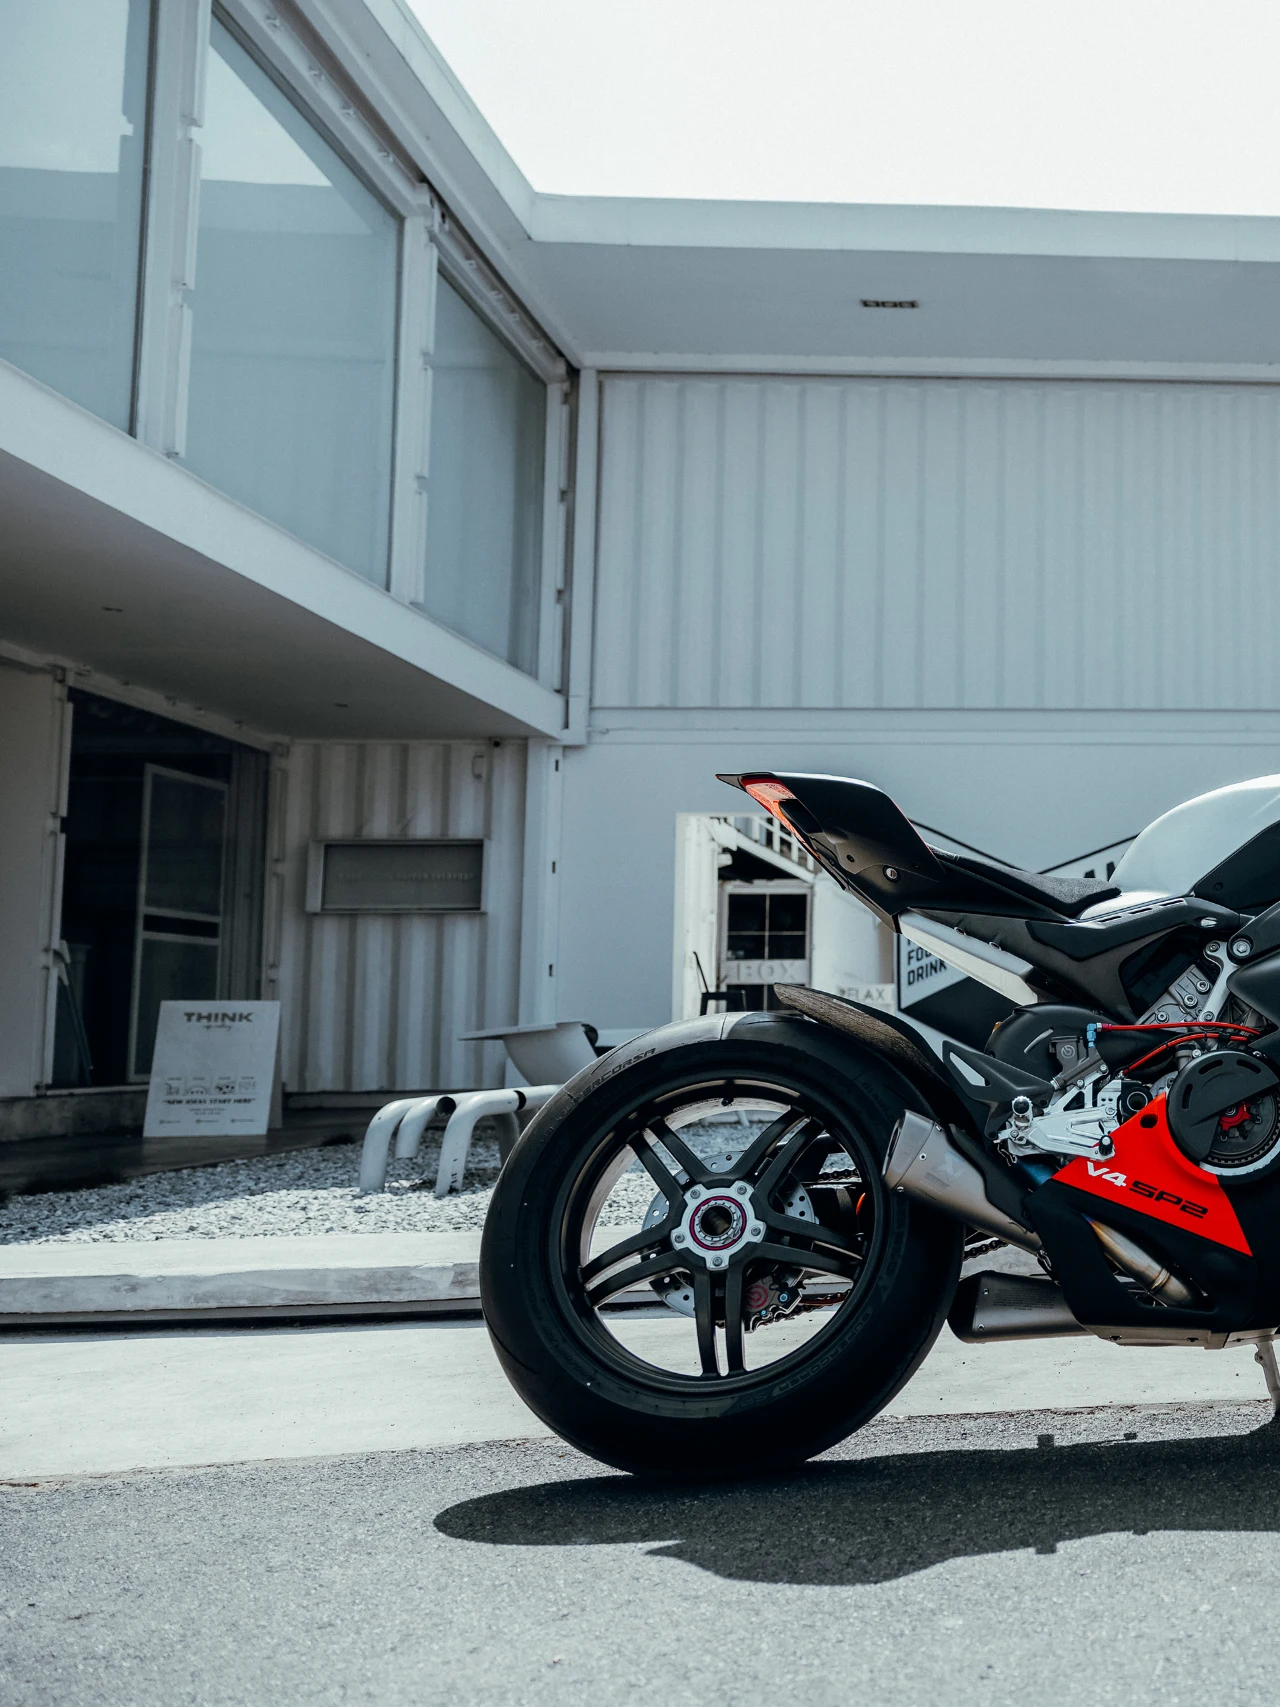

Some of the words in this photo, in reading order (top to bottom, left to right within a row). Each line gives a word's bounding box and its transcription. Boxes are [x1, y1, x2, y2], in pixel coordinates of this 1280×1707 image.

[737, 961, 797, 982] BOX
[907, 958, 947, 986] DRINK
[184, 1012, 254, 1023] THINK
[1087, 1161, 1127, 1187] V4
[1129, 1180, 1208, 1219] SP2
